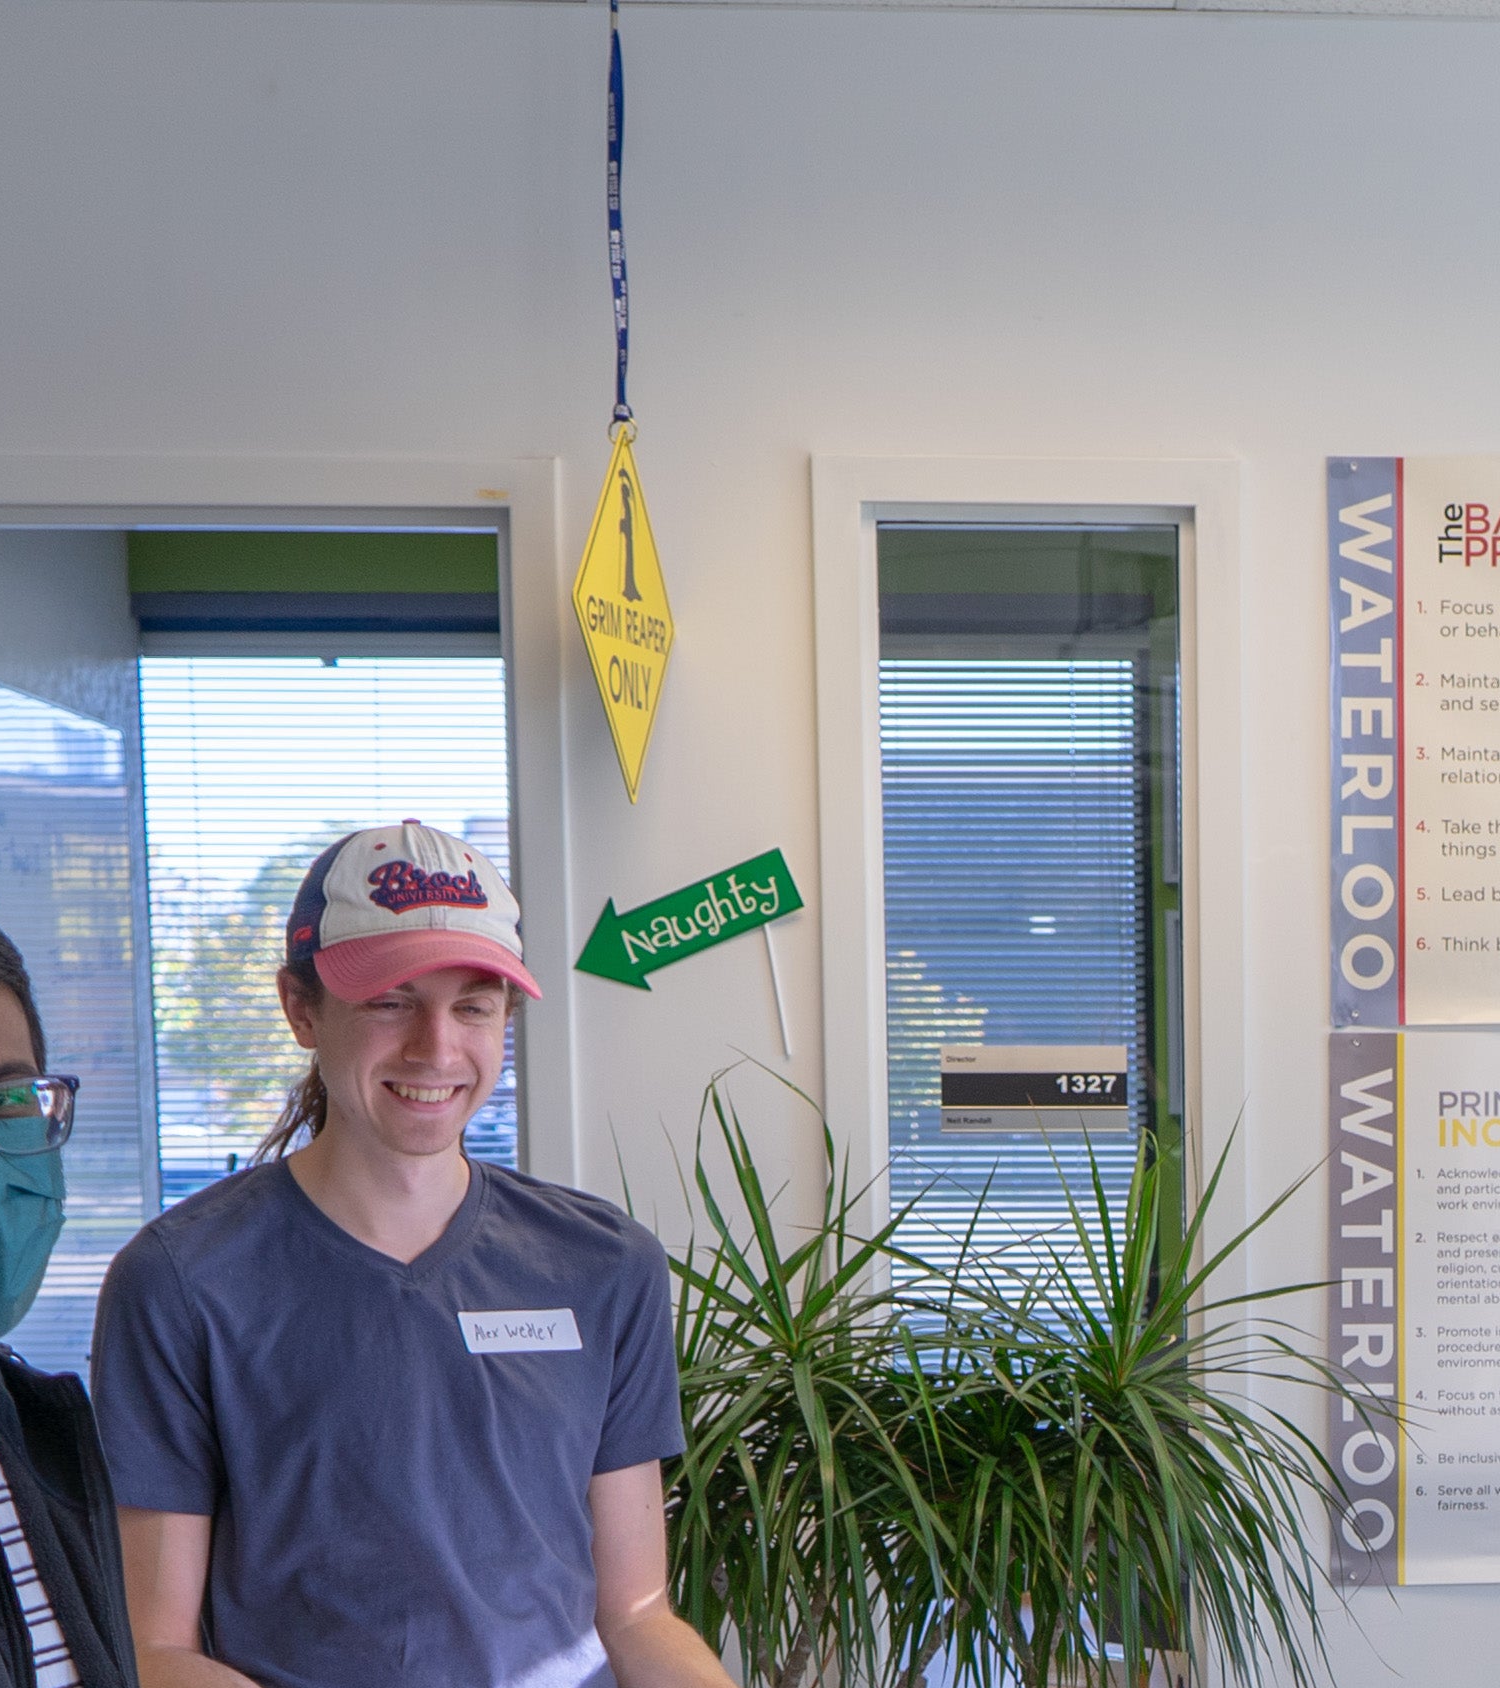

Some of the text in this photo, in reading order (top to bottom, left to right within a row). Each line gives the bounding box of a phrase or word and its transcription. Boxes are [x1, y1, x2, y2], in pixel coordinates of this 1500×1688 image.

[1437, 502, 1464, 564] The
[1417, 600, 1428, 615] 1.
[1439, 599, 1495, 616] Focus
[586, 595, 668, 657] GRIM REAPER
[1439, 625, 1460, 638] or
[608, 655, 653, 713] ONLY
[1415, 673, 1430, 687] 2.
[1439, 695, 1474, 712] and
[1338, 492, 1396, 992] WATERLOO
[1416, 747, 1430, 761] 3.
[1416, 820, 1431, 834] 4.
[1440, 818, 1482, 835] Take
[1440, 841, 1497, 861] things
[368, 860, 485, 900] Brock
[386, 889, 464, 904] UNIVERSITY
[1417, 887, 1431, 902] 5.
[1441, 886, 1486, 903] Lead
[619, 872, 781, 966] Naughty
[1416, 937, 1431, 951] 6.
[1440, 936, 1491, 953] Think
[946, 1055, 977, 1064] Director
[1055, 1074, 1118, 1095] 1327
[946, 1117, 992, 1125] Neil Randall
[1416, 1168, 1426, 1180] 1.
[1339, 1067, 1397, 1554] WATERLOO
[473, 1322, 499, 1341] Alex
